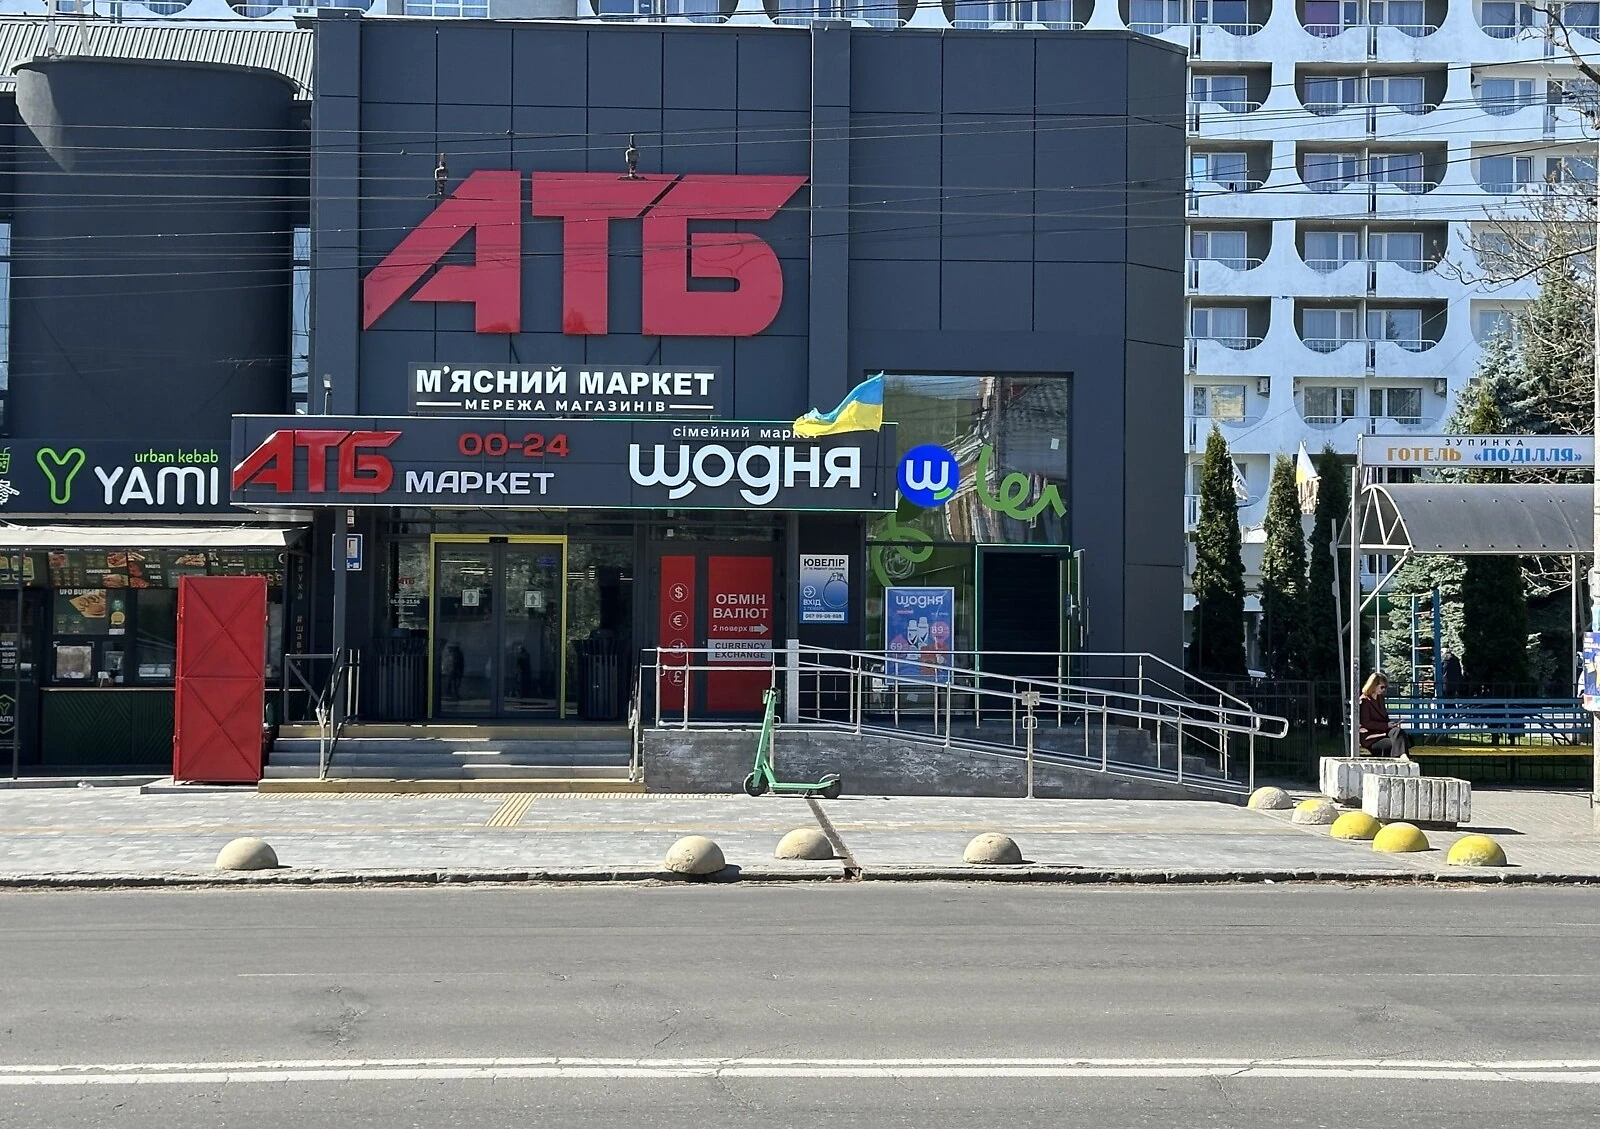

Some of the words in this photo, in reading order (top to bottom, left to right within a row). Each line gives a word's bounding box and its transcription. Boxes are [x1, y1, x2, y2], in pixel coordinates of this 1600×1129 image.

[363, 170, 808, 337] АТБ
[579, 372, 715, 396] МАРКЕТ
[465, 399, 546, 411] МЕРЕЖА
[556, 400, 666, 413] МАГАЗИНІВ
[672, 425, 750, 439] сімейний
[458, 433, 570, 457] 00-24
[1445, 438, 1525, 446] ЗУПИНКА
[135, 448, 175, 463] urban
[178, 448, 219, 463] kebab
[233, 429, 403, 493] АТБ
[1387, 447, 1462, 462] ГОТЕЛЬ
[1474, 448, 1582, 464] «ПОДІЛЛЯ»
[629, 443, 861, 505] щодня
[94, 466, 219, 505] YAMI
[405, 471, 554, 494] МАРКЕТ
[803, 558, 846, 567] ЮВЕЛІР
[674, 586, 683, 599] $
[715, 593, 766, 605] ОБМІН
[895, 595, 944, 609] щодня
[673, 614, 683, 626] €
[713, 608, 769, 619] ВАЛЮТ
[931, 626, 944, 634] 89
[715, 642, 766, 651] CURRENCY
[890, 642, 903, 650] 69
[715, 651, 766, 659] EXCHANGE
[673, 670, 683, 683] £
